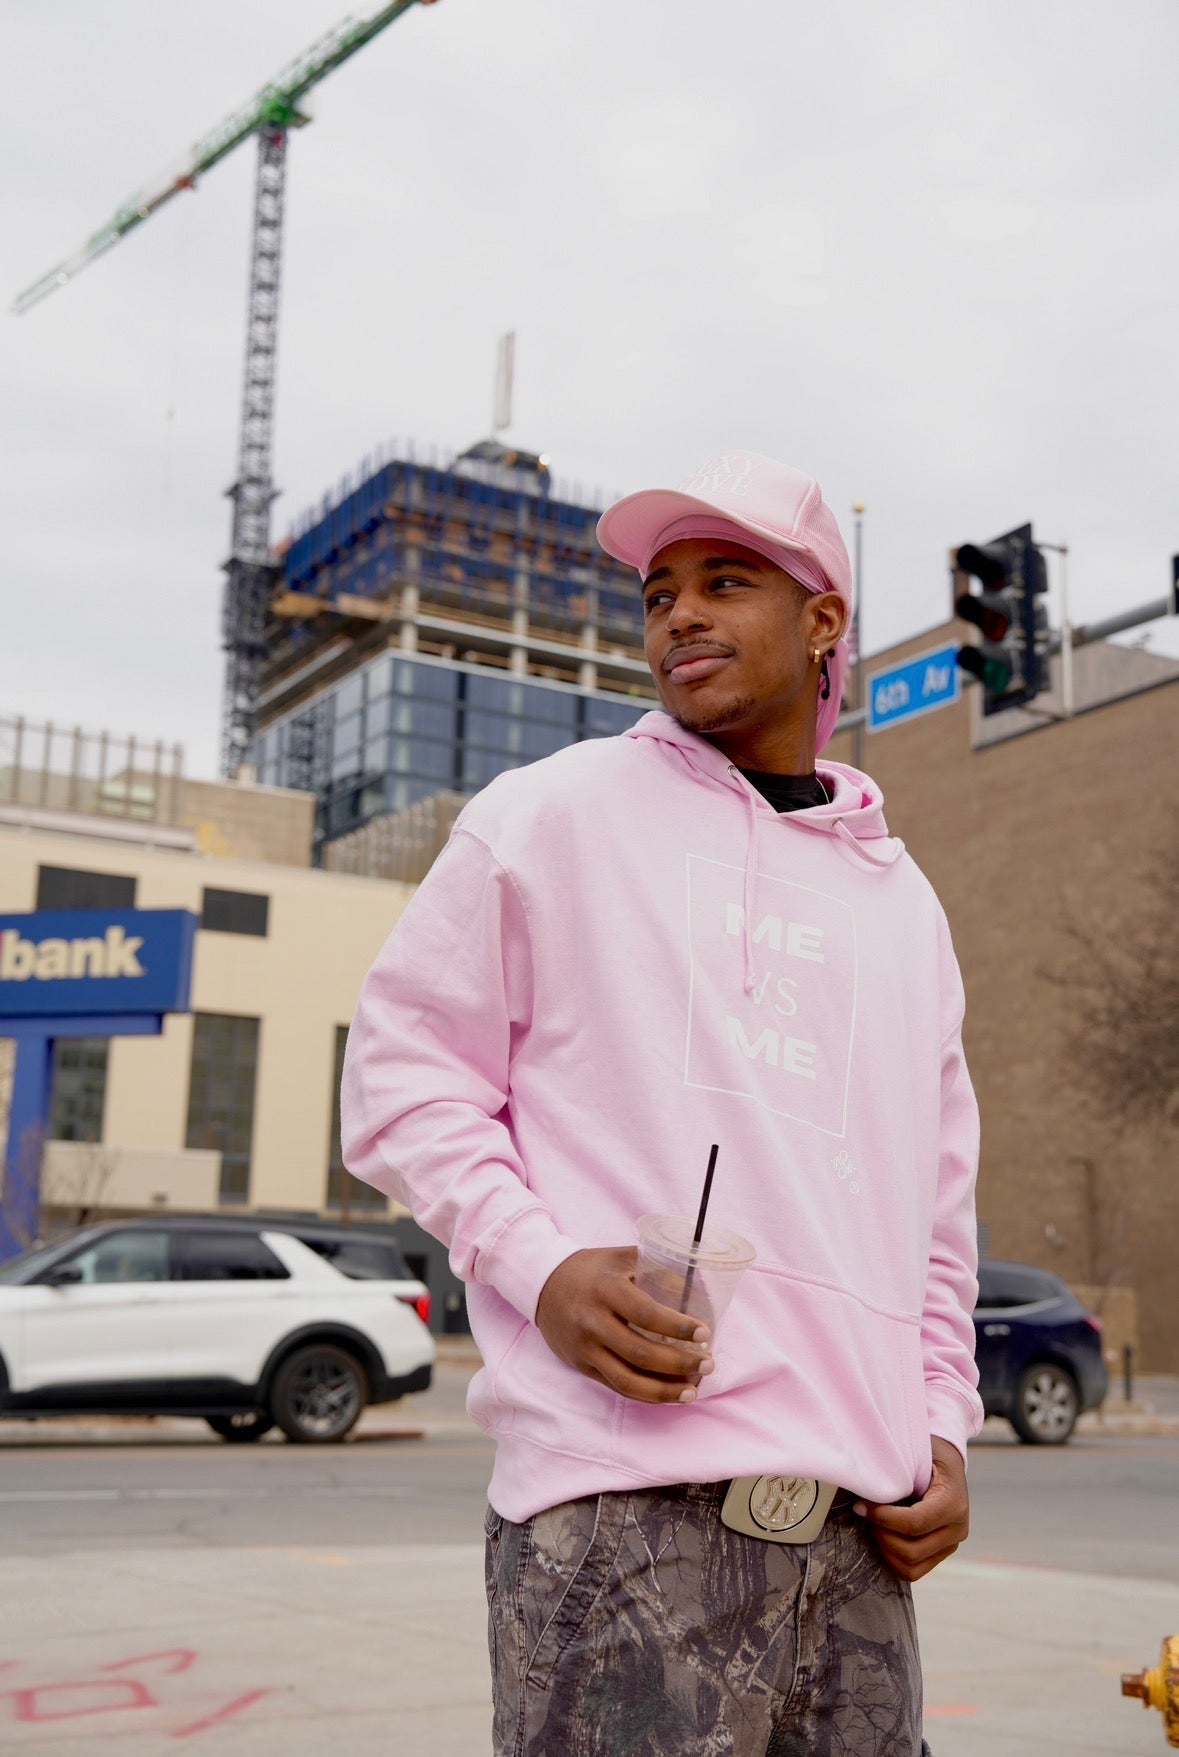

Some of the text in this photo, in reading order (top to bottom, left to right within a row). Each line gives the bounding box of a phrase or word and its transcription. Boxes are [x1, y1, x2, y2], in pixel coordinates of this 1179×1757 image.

[1, 925, 146, 981] bank
[726, 902, 825, 964] ME
[750, 971, 799, 1017] VS
[724, 1014, 817, 1081] ME
